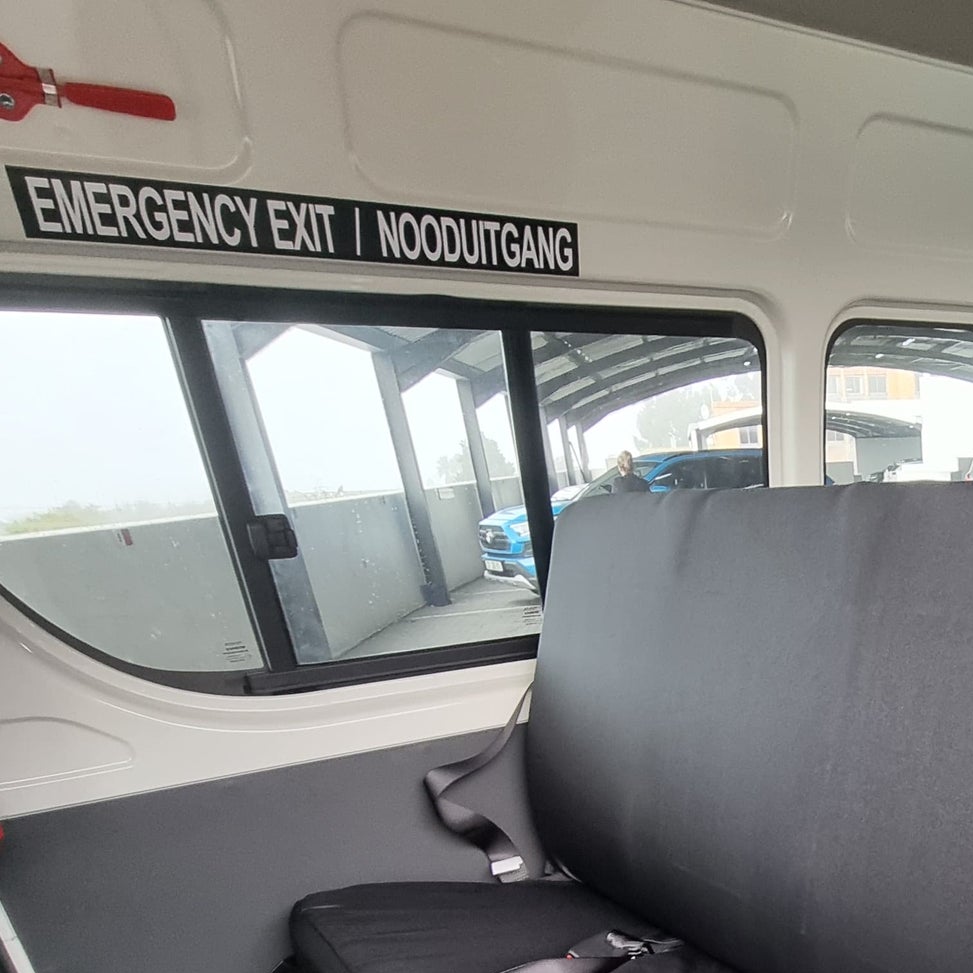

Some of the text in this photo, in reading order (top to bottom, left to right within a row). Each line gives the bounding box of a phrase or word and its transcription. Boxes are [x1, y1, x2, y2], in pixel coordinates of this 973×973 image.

[24, 175, 258, 247] EMERGENCY
[268, 201, 335, 253] EXIT
[377, 209, 573, 271] NOODUITGANG
